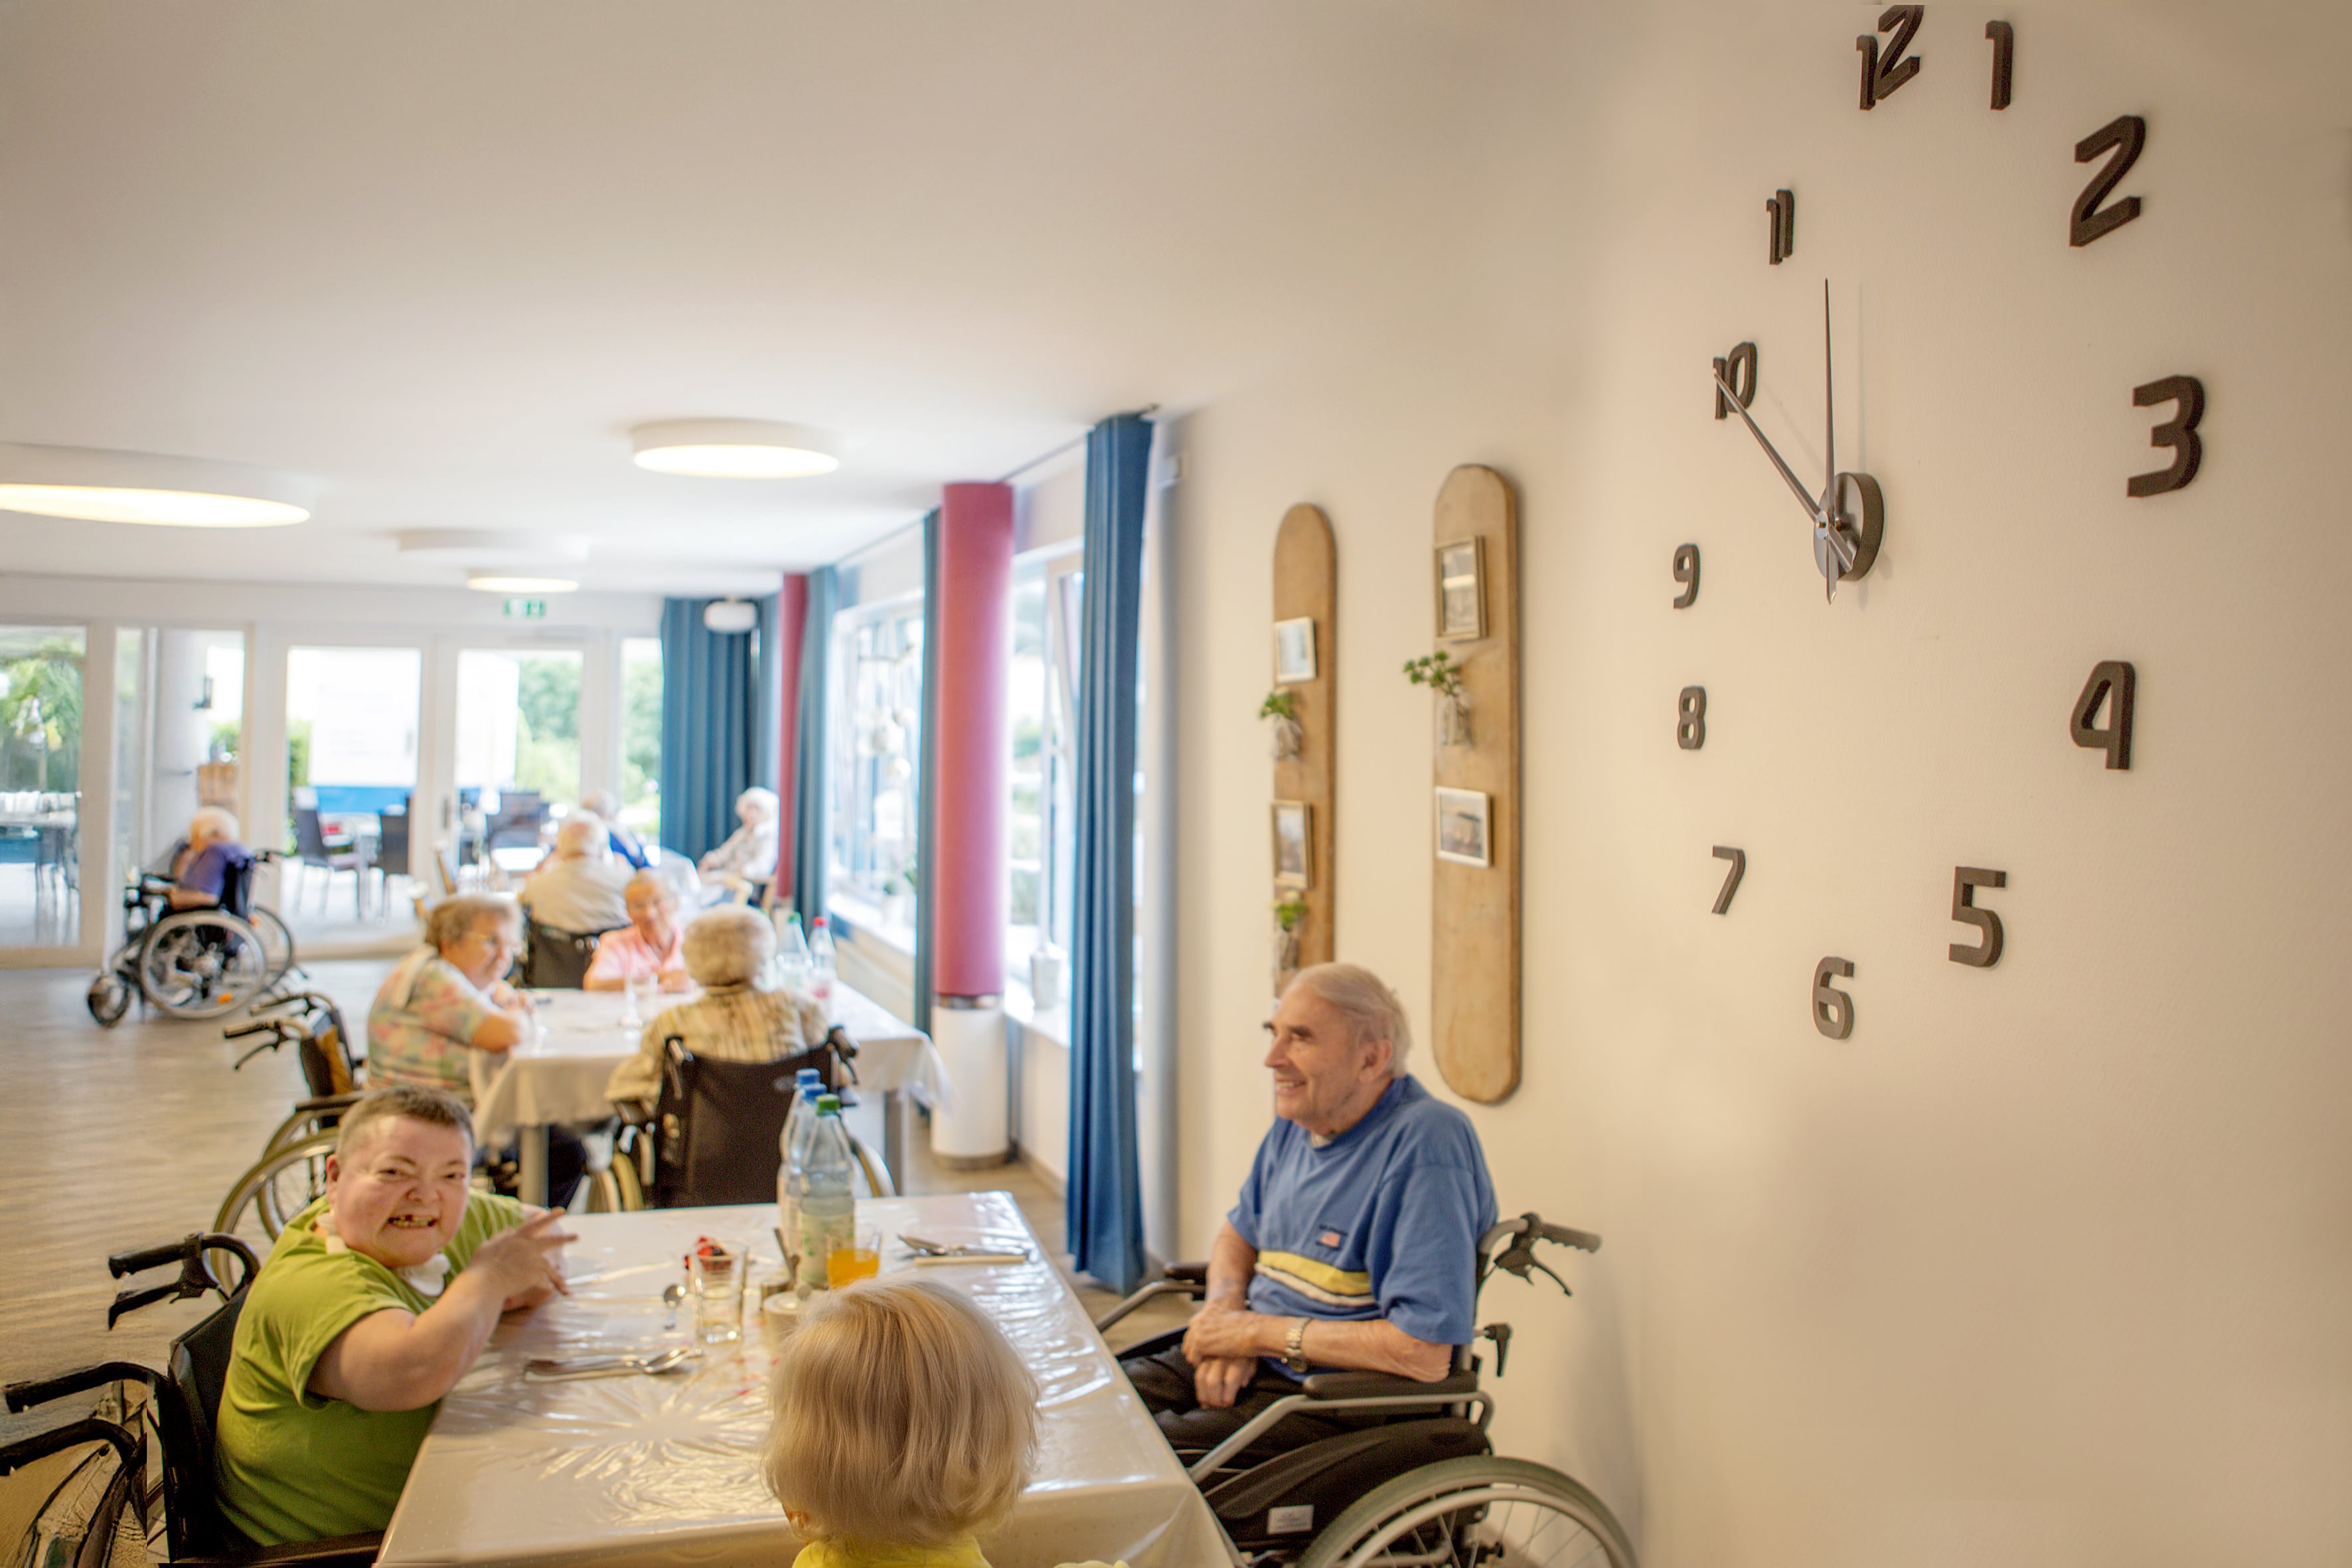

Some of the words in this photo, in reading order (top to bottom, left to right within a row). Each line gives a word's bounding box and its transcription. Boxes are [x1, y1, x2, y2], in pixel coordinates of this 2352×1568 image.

[1857, 5, 1924, 110] 12
[1985, 21, 2013, 110] 1
[2069, 116, 2146, 247] 2
[1766, 189, 1794, 265] 11
[1713, 342, 1757, 420] 10
[2127, 376, 2205, 497] 3
[1673, 544, 1700, 609] 9
[1677, 686, 1706, 749] 8
[2070, 661, 2136, 770] 4
[1711, 845, 1746, 915] 7
[1948, 866, 2007, 967] 5
[1812, 957, 1855, 1040] 6
